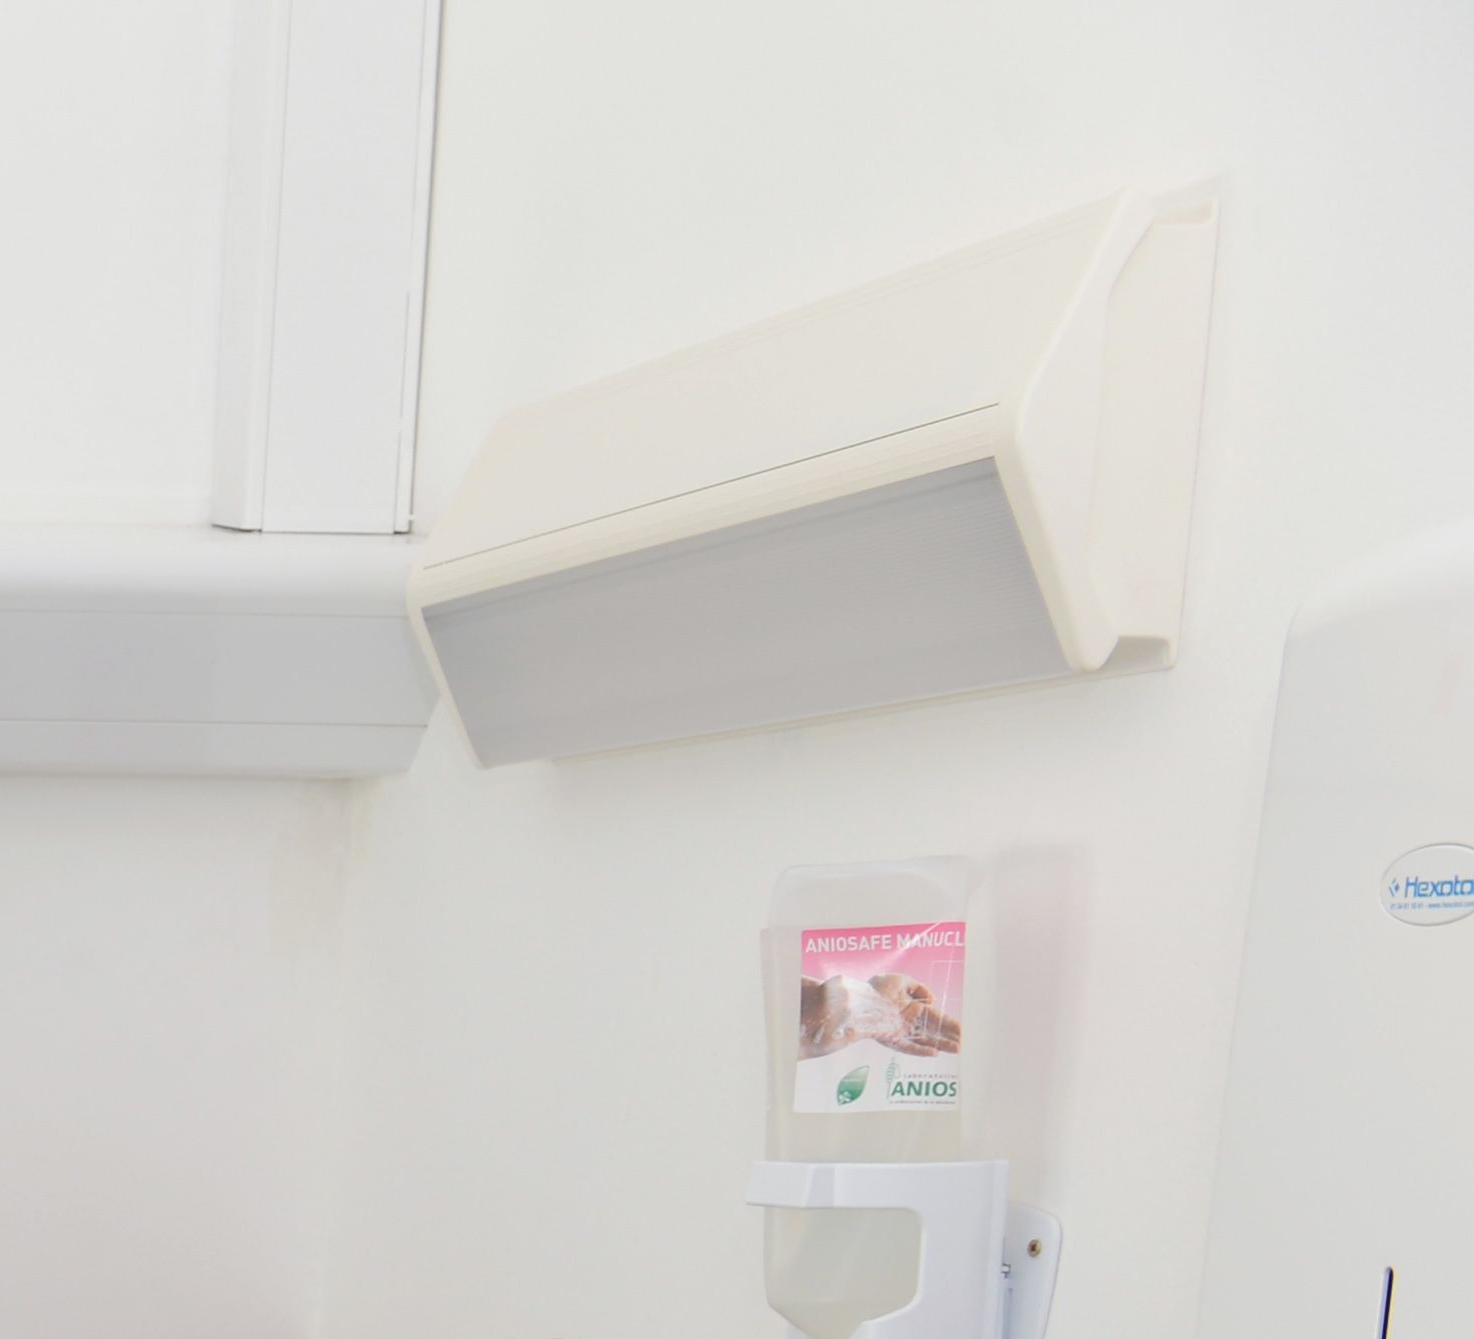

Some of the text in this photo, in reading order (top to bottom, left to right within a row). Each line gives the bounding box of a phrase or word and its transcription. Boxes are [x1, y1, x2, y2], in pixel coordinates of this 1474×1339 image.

[1404, 874, 1474, 898] Hexoto
[805, 931, 965, 953] ANIOSAFE MANUCL
[891, 1081, 957, 1097] ANIOS
